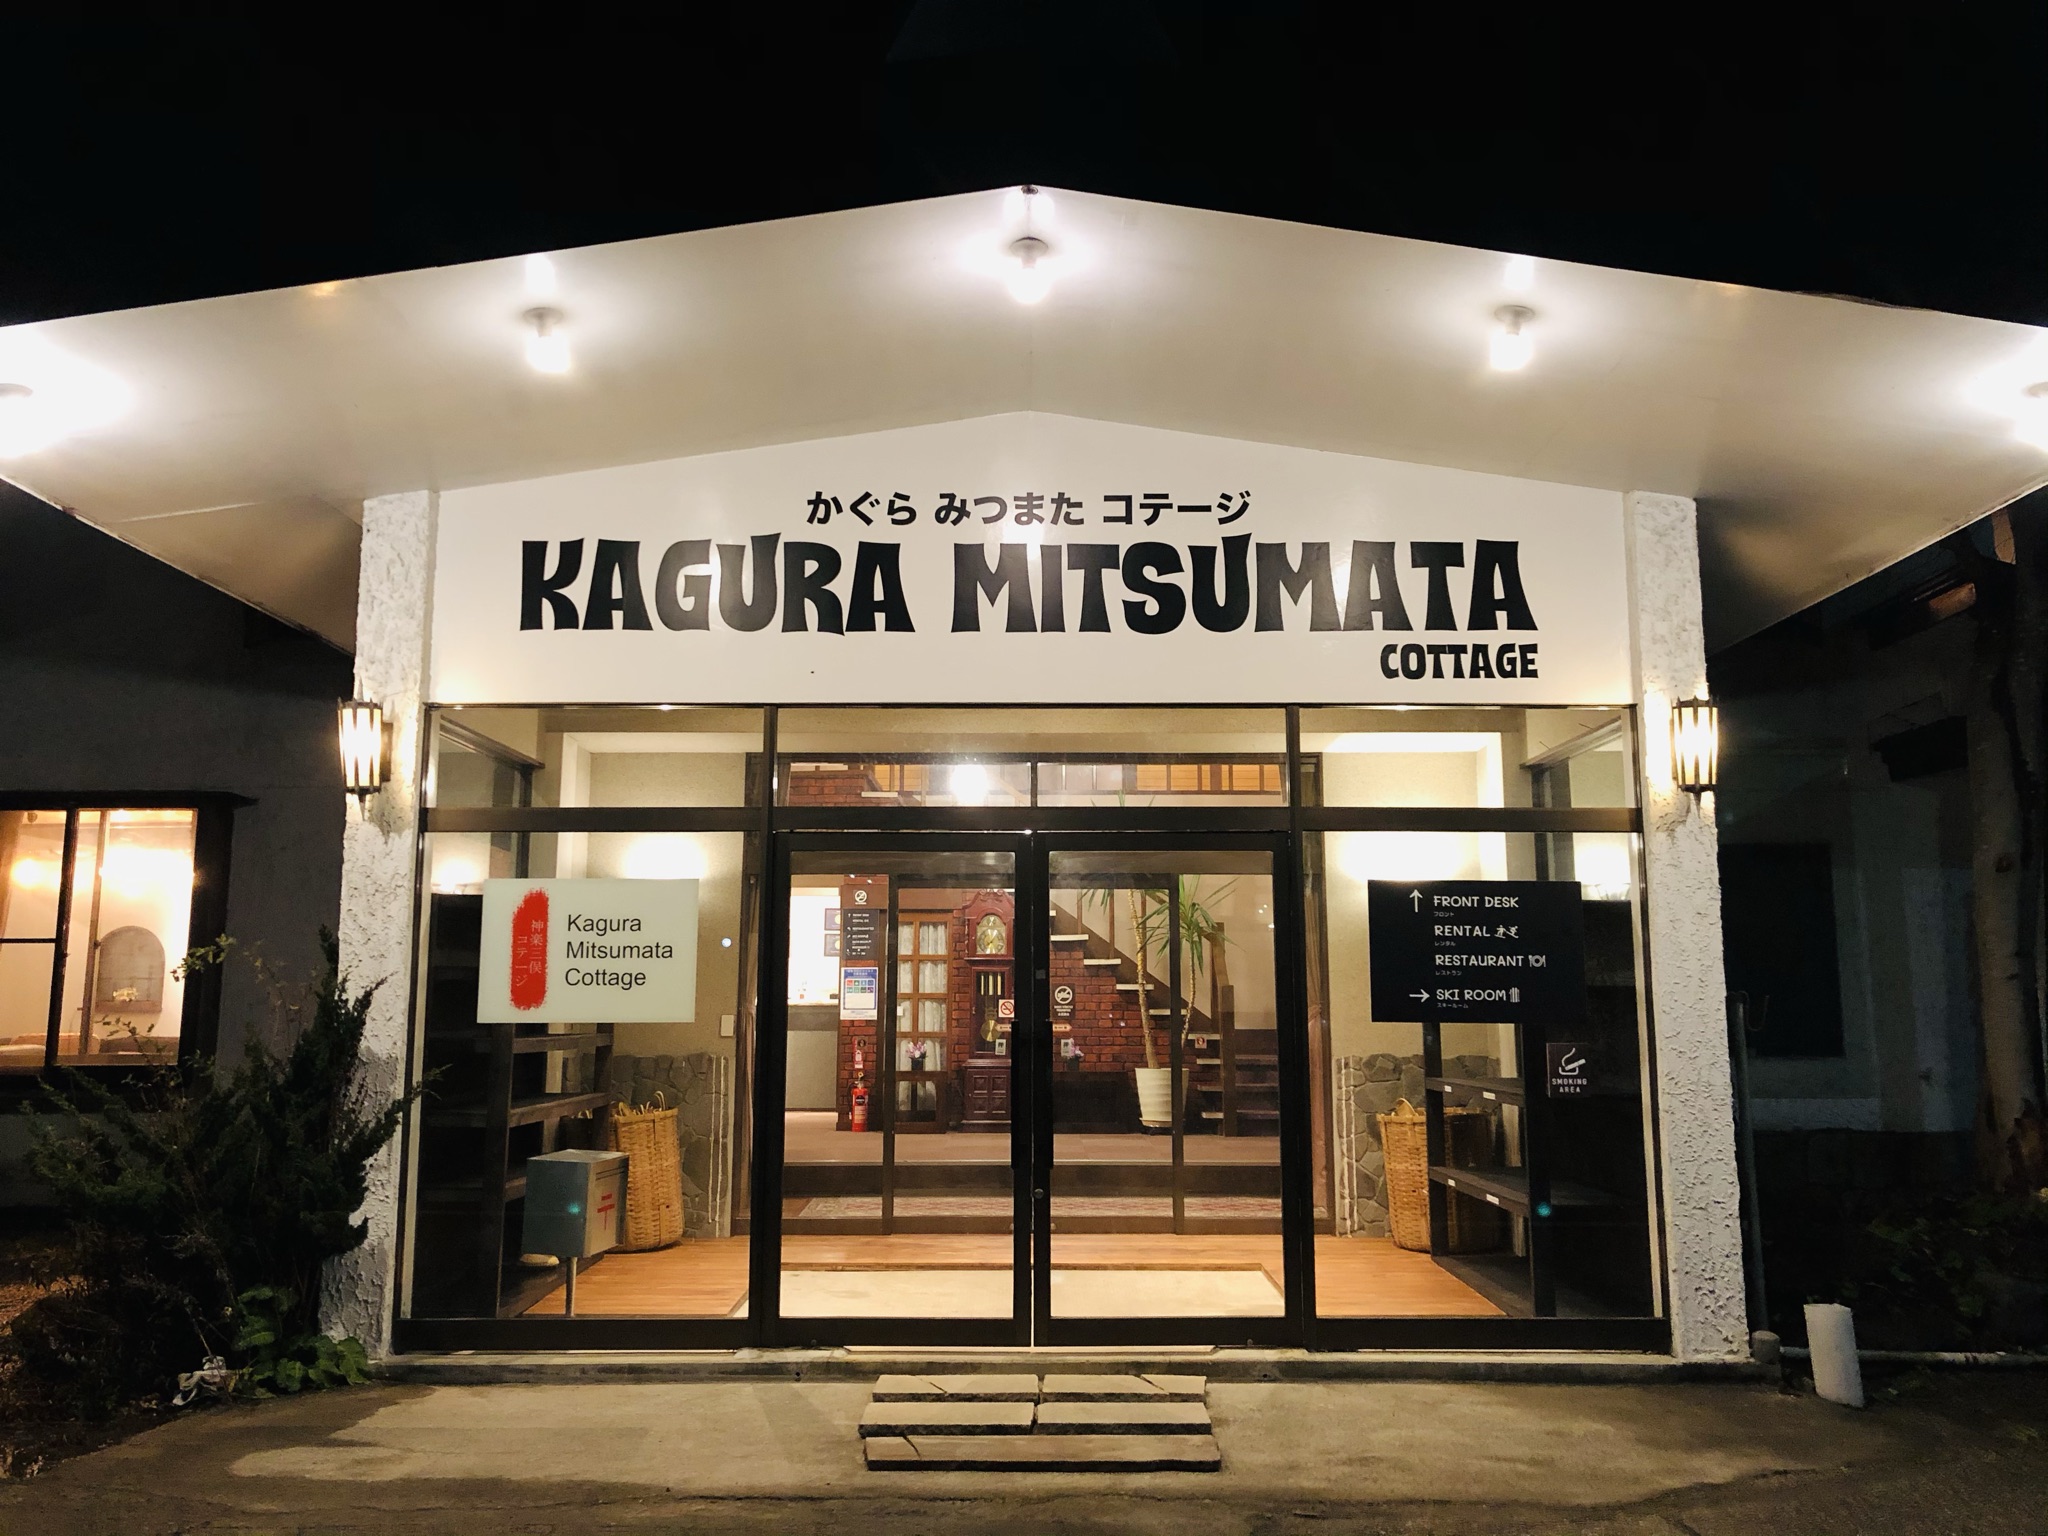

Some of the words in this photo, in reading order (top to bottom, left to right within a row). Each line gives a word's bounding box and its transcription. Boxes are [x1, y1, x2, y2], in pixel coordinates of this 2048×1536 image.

[806, 490, 917, 527] かぐら
[934, 491, 1085, 527] みつまた
[1103, 490, 1251, 527] コテージ
[520, 532, 916, 636] KAGURA
[951, 532, 1539, 635] MITSUMATA
[1380, 642, 1539, 679] COTTAGE
[1433, 895, 1480, 908] FRONT
[1485, 896, 1519, 908] DESK
[567, 914, 642, 937] Kagura
[1434, 925, 1491, 937] RENTAL
[528, 919, 544, 975] 神楽三俣
[566, 941, 673, 959] Mitsumata
[515, 934, 528, 987] コテージ
[1435, 954, 1524, 967] RESTAURANT
[565, 967, 647, 990] Cottage
[1436, 988, 1460, 1001] SKI
[1464, 989, 1507, 1001] ROOM
[1551, 1078, 1588, 1086] SMOKING
